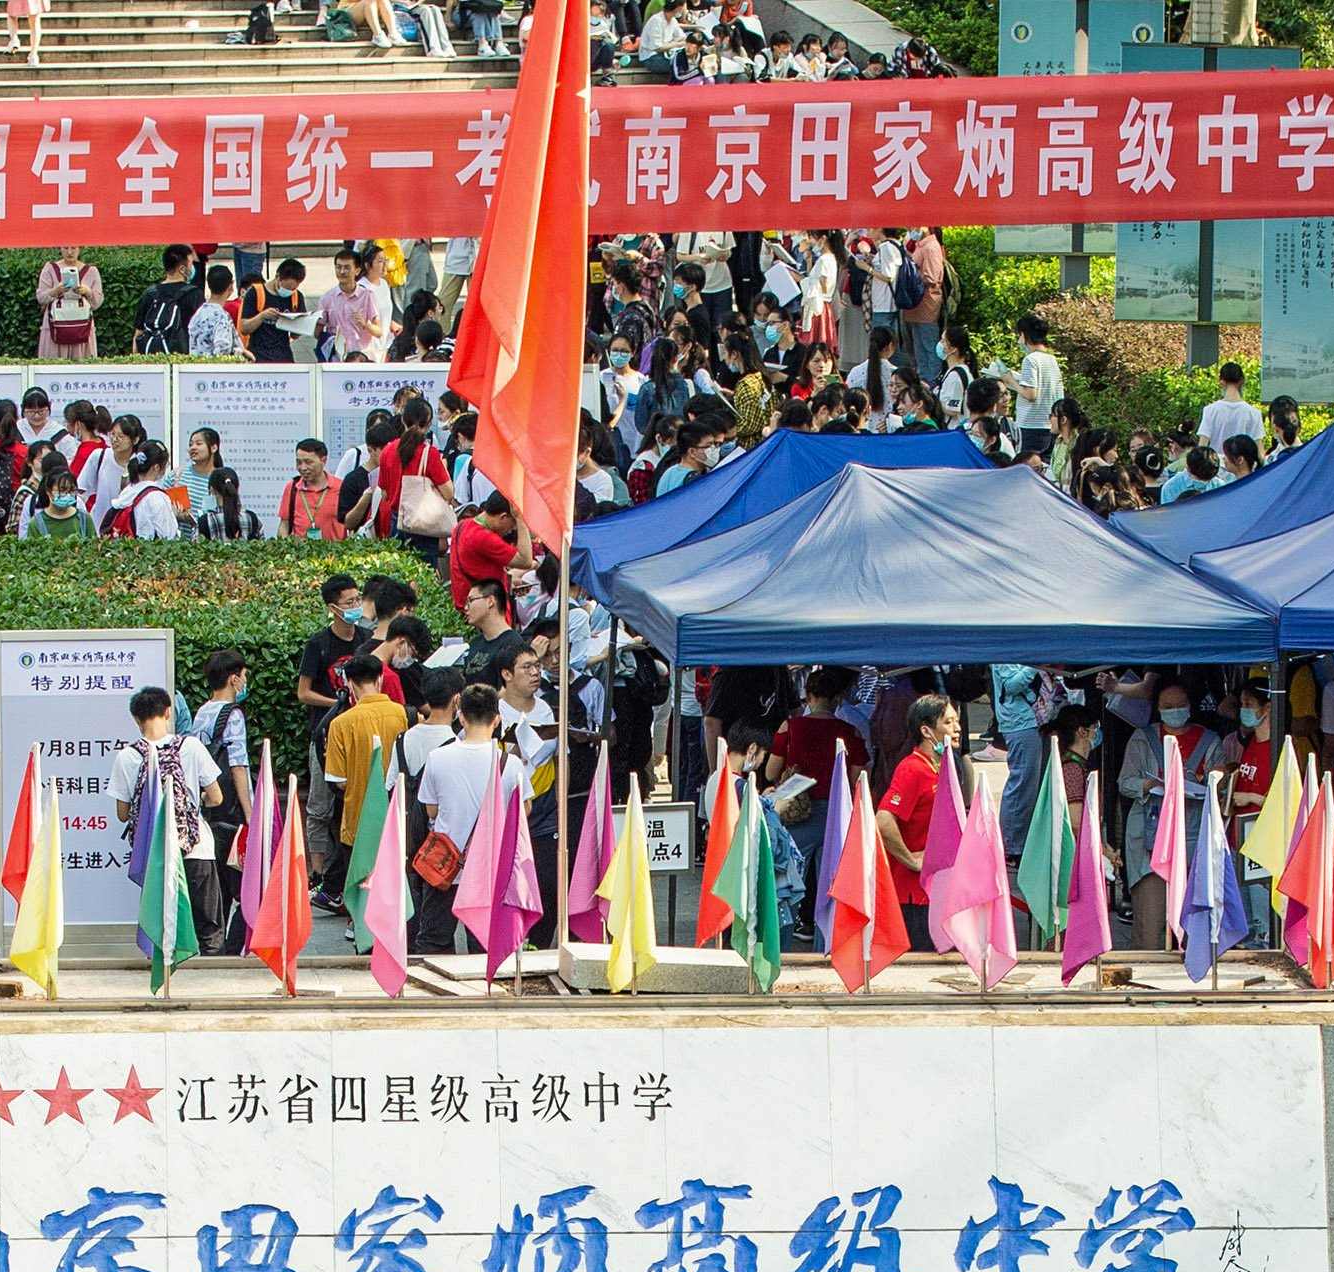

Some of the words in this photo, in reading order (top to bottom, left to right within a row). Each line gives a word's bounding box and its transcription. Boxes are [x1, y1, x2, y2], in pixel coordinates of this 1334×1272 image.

[38, 651, 137, 664] 南京田家炳高级中学
[30, 675, 135, 691] 特别提醒
[62, 816, 108, 831] 14:45
[177, 1071, 673, 1126] 江苏省四星级高级中学
